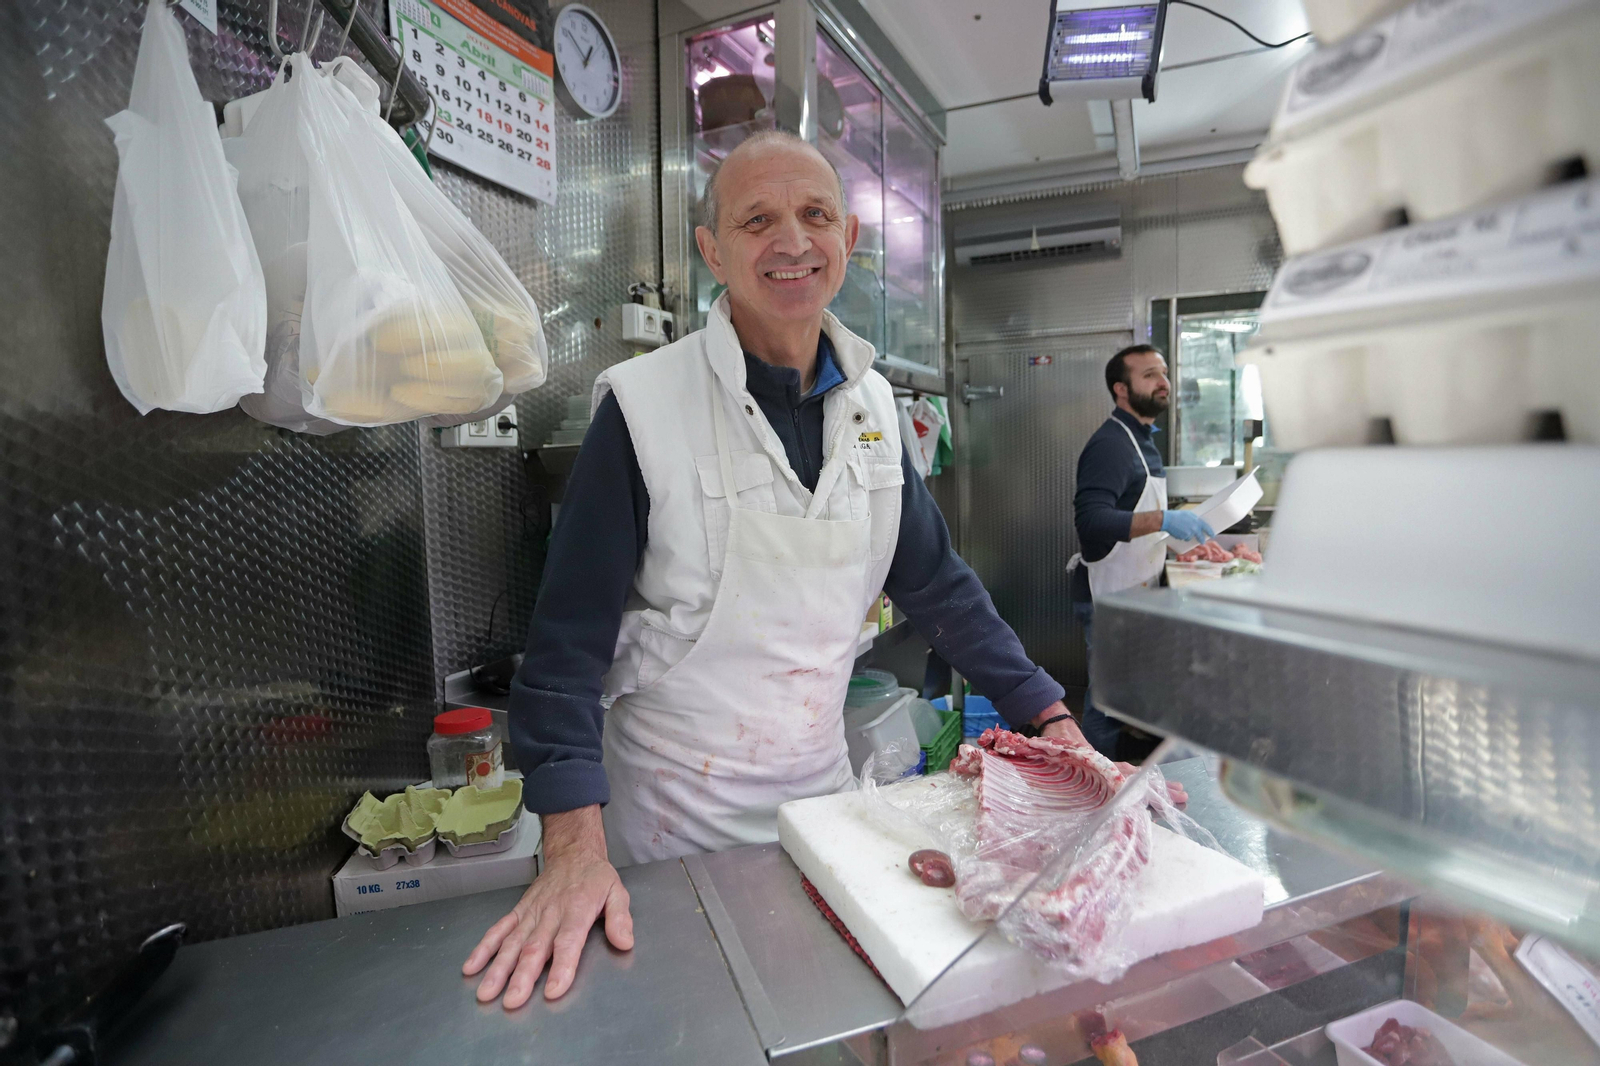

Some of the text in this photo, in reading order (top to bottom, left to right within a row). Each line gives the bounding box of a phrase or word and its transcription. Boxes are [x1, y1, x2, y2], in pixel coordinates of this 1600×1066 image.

[411, 28, 545, 112] 1 2 3 4 5 6 7
[460, 40, 496, 67] Abril
[412, 49, 550, 133] 8 9 10 11 12 13 14
[433, 84, 451, 102] 16
[455, 96, 472, 112] 17
[476, 108, 493, 124] 18
[496, 119, 513, 134] 19
[516, 128, 532, 143] 20
[535, 137, 549, 151] 21
[436, 127, 454, 144] 30
[437, 105, 551, 171] 23 24 25 26 27 28
[356, 884, 384, 895] 10 KG.
[395, 879, 421, 890] 27x38
